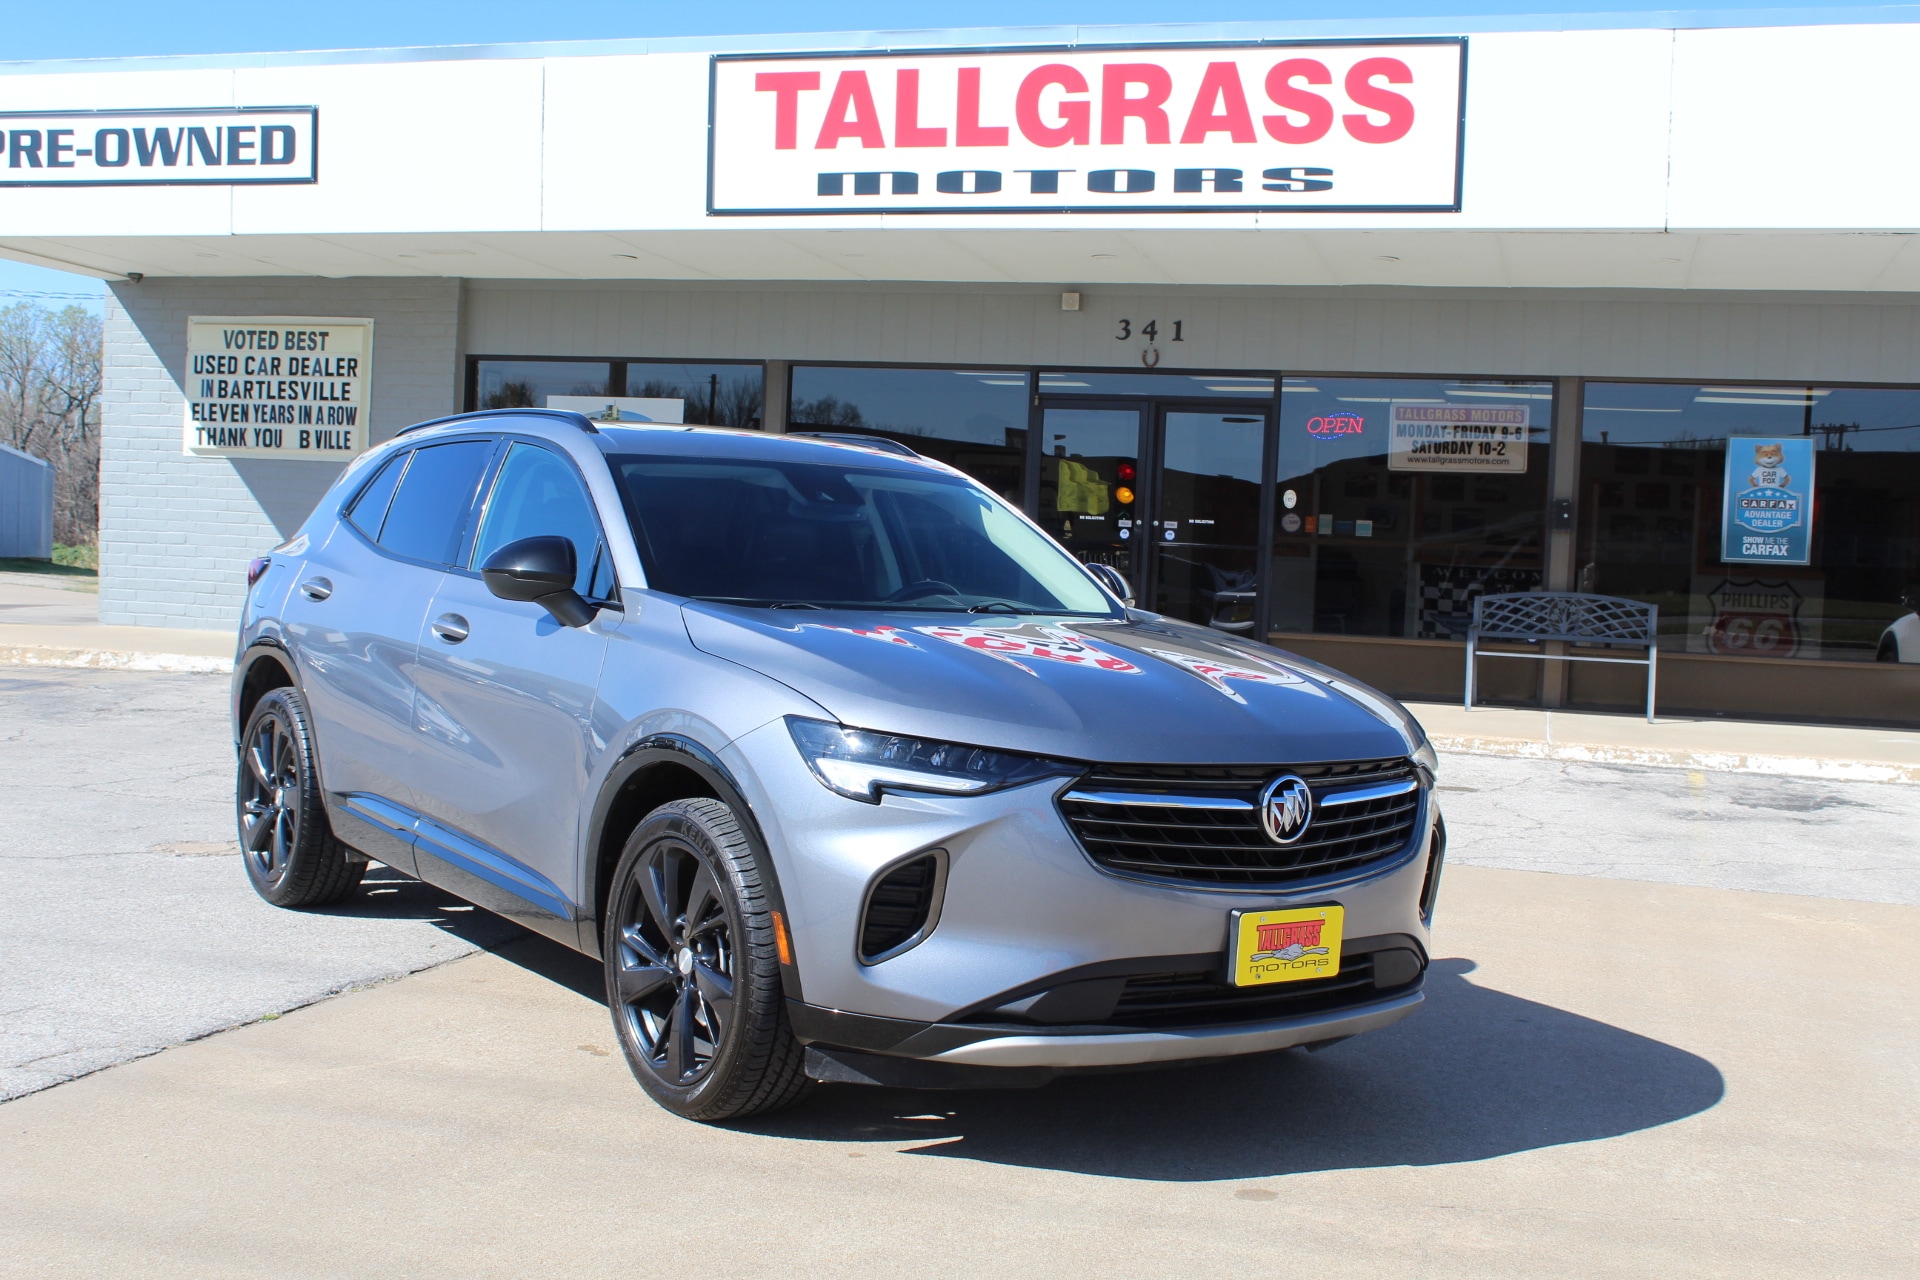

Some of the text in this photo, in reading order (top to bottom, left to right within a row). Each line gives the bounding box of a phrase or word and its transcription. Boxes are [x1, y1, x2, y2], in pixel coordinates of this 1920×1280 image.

[755, 57, 1415, 149] TALLGRASS
[0, 125, 296, 168] RE-OWNED
[817, 167, 1334, 196] MOTORS
[1115, 318, 1184, 342] 341
[223, 329, 329, 351] VOTED BEST
[194, 355, 358, 377] USED CAR DEALER
[201, 379, 351, 401] IN BARTLESVILLE
[192, 402, 357, 426] ELEVEN YEARS IN A ROW
[1399, 407, 1523, 422] TALLGRASS MOTORS
[1307, 416, 1365, 434] OPEN
[1396, 423, 1523, 441] MONDAY-FRIDAY 9-6
[196, 427, 351, 450] THANK YOU B VILLE
[1411, 440, 1506, 456] SATURDAY 10-2
[1407, 456, 1510, 466] www.tallgrassmotors.com
[1741, 499, 1796, 510] CARFAX
[1744, 510, 1792, 519] ADVANTAGE
[1752, 519, 1783, 527] DEALER
[1742, 536, 1764, 544] SHOW
[1776, 537, 1789, 545] THE
[1742, 544, 1789, 556] CARFAX
[1722, 592, 1789, 610] PHILLIPS
[1725, 617, 1784, 650] 66
[681, 820, 718, 867] KENDA
[1250, 958, 1330, 974] MOTORS
